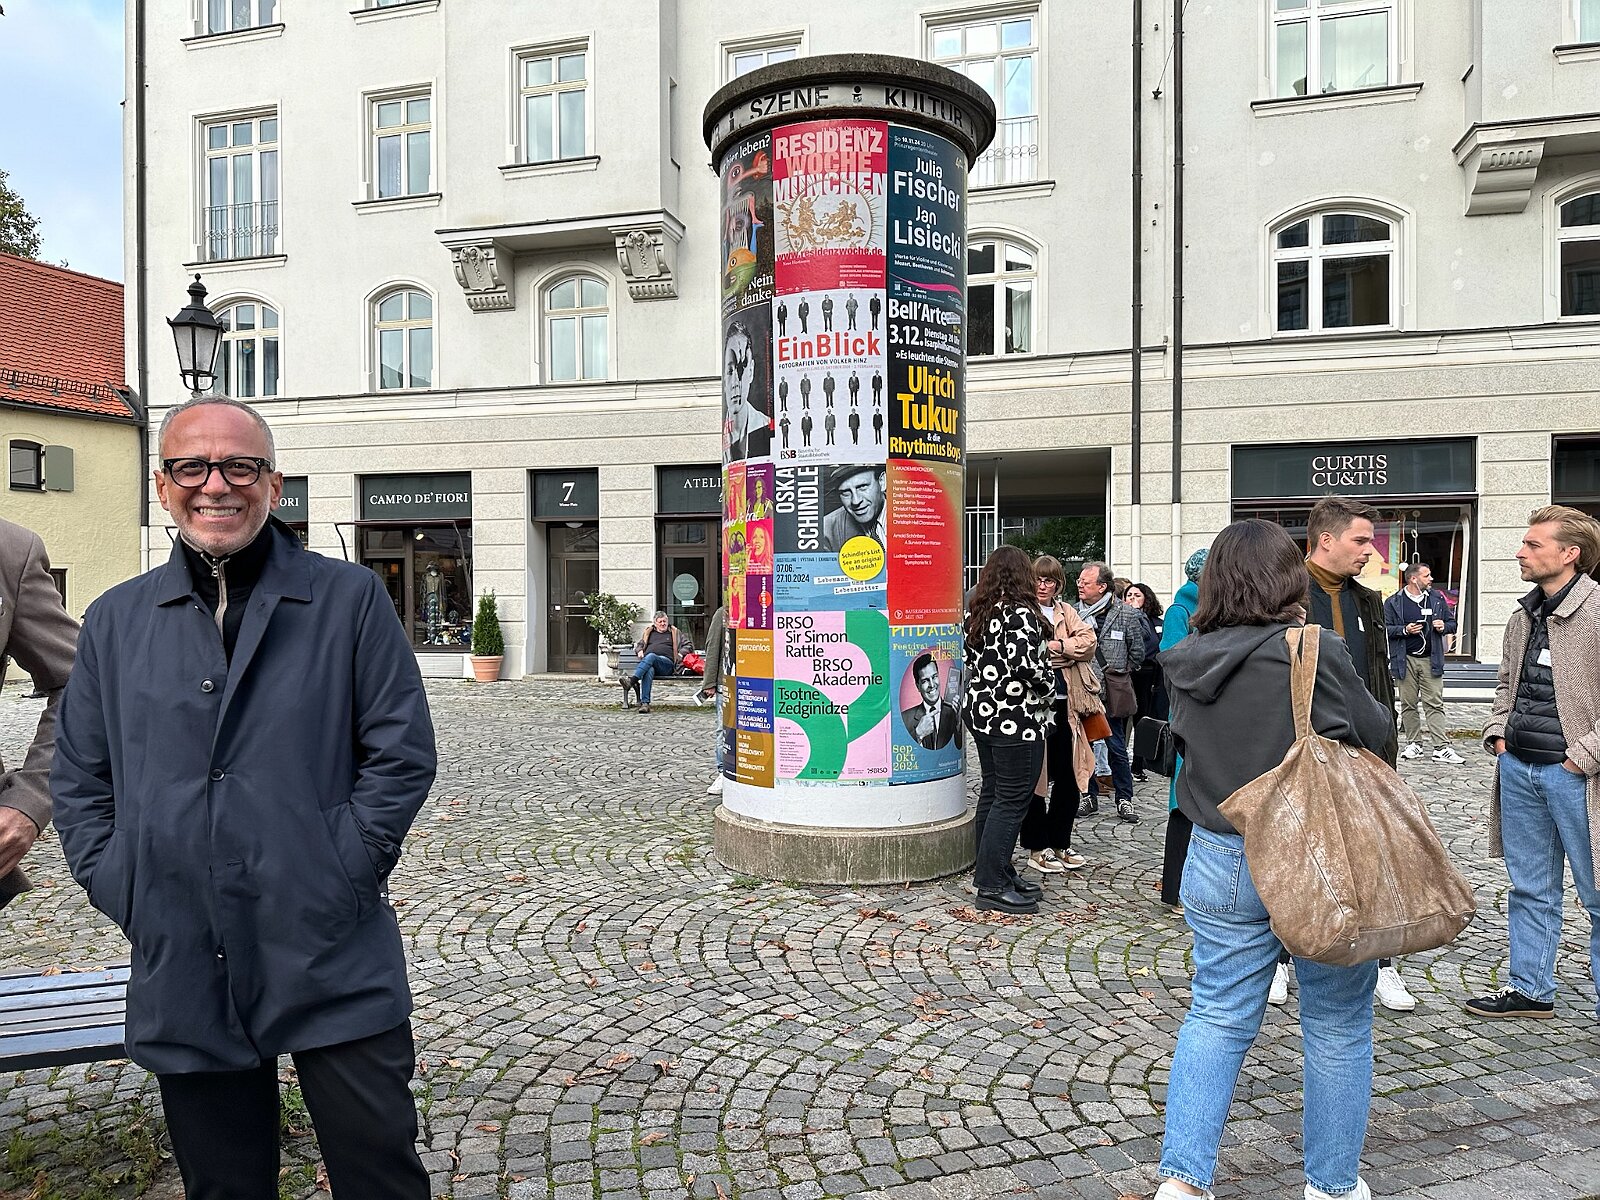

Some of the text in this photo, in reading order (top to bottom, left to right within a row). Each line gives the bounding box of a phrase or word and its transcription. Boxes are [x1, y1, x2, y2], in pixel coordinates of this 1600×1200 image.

[739, 134, 771, 159] leben?
[775, 130, 883, 160] RESIDENZ
[786, 151, 871, 177] WOCHE
[915, 157, 943, 179] Julia
[773, 170, 886, 202] MÜNCHEN
[894, 170, 960, 212] Fischer
[915, 205, 937, 226] Jan
[894, 219, 961, 261] Lisiecki
[776, 246, 883, 261] www.residenzwoche.de
[748, 274, 774, 290] Nein
[889, 298, 948, 326] Bell'Arte
[889, 324, 924, 346] 3.12.
[924, 327, 947, 344] Dienstag
[778, 331, 881, 361] EinBlick
[779, 359, 814, 369] FOTOGRAFIEN
[908, 350, 935, 363] leuchten
[936, 354, 944, 365] die
[908, 365, 955, 399] Ulrich
[896, 393, 959, 435] Tukur
[927, 432, 941, 442] & die
[780, 450, 797, 460] BSB
[890, 436, 961, 462] Rhythmus Boys
[1312, 454, 1387, 470] CURTIS
[683, 477, 722, 488] ATELI
[1312, 470, 1387, 486] CU&TIS
[562, 482, 575, 502] 7
[775, 466, 795, 514] OSKA
[279, 497, 299, 507] ORI
[369, 494, 412, 505] CAMPO
[435, 492, 469, 503] FIORI
[797, 466, 819, 550] SCHINDLE
[841, 550, 870, 558] Schindler's
[861, 556, 881, 565] original
[776, 564, 795, 573] 07.06.
[855, 563, 877, 571] Munich!
[776, 574, 810, 583] 27.10.2024
[835, 585, 879, 594] Lebensretter
[777, 616, 814, 629] BRSO
[786, 629, 848, 643] Sir Simon
[737, 643, 771, 652] grenzenlos
[786, 644, 825, 657] Rattle
[892, 642, 928, 650] Festival
[813, 658, 853, 672] BRSO
[812, 672, 883, 686] Akademie
[778, 687, 820, 701] Tsotne
[778, 701, 849, 719] Zedginidze
[896, 753, 916, 762] Okt
[892, 761, 919, 771] 2024
